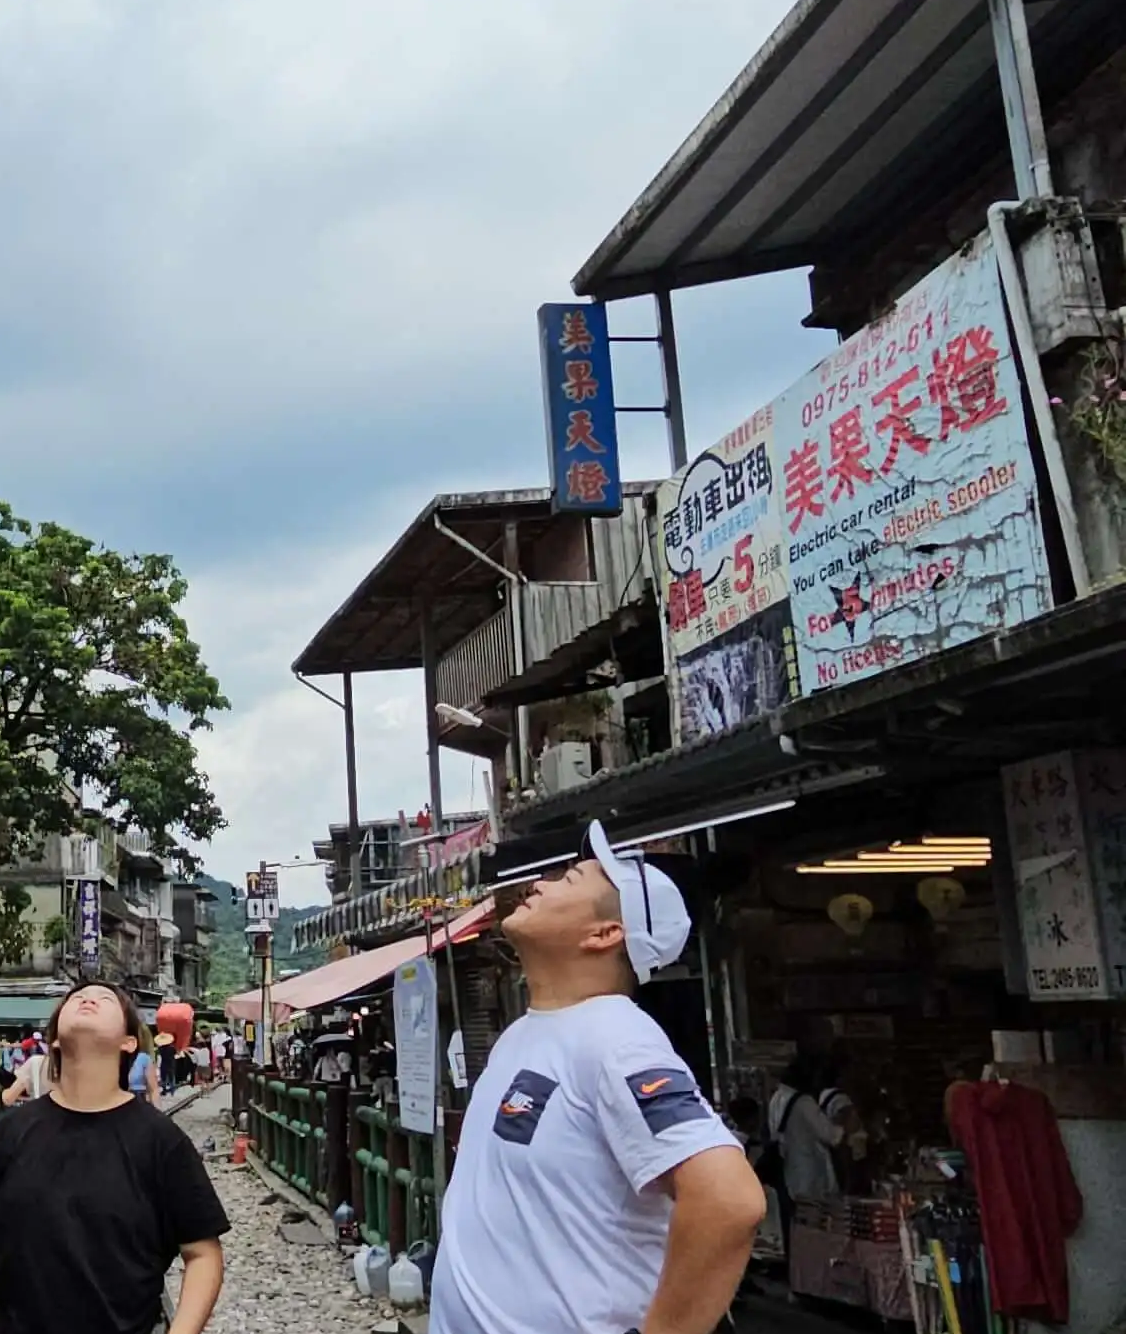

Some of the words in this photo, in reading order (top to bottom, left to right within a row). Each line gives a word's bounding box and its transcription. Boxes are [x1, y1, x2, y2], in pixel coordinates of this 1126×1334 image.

[558, 309, 611, 503] 美果天燈
[782, 324, 1008, 535] 美果天燈
[663, 441, 773, 550] 電動車出租
[788, 528, 837, 564] Electric
[840, 509, 864, 534] car
[867, 475, 917, 518] rental
[733, 533, 755, 595] 5
[792, 573, 816, 597] You
[818, 557, 845, 577] can
[847, 538, 880, 570] take
[881, 497, 943, 543] electric
[839, 586, 863, 622] 5
[816, 660, 839, 686] No
